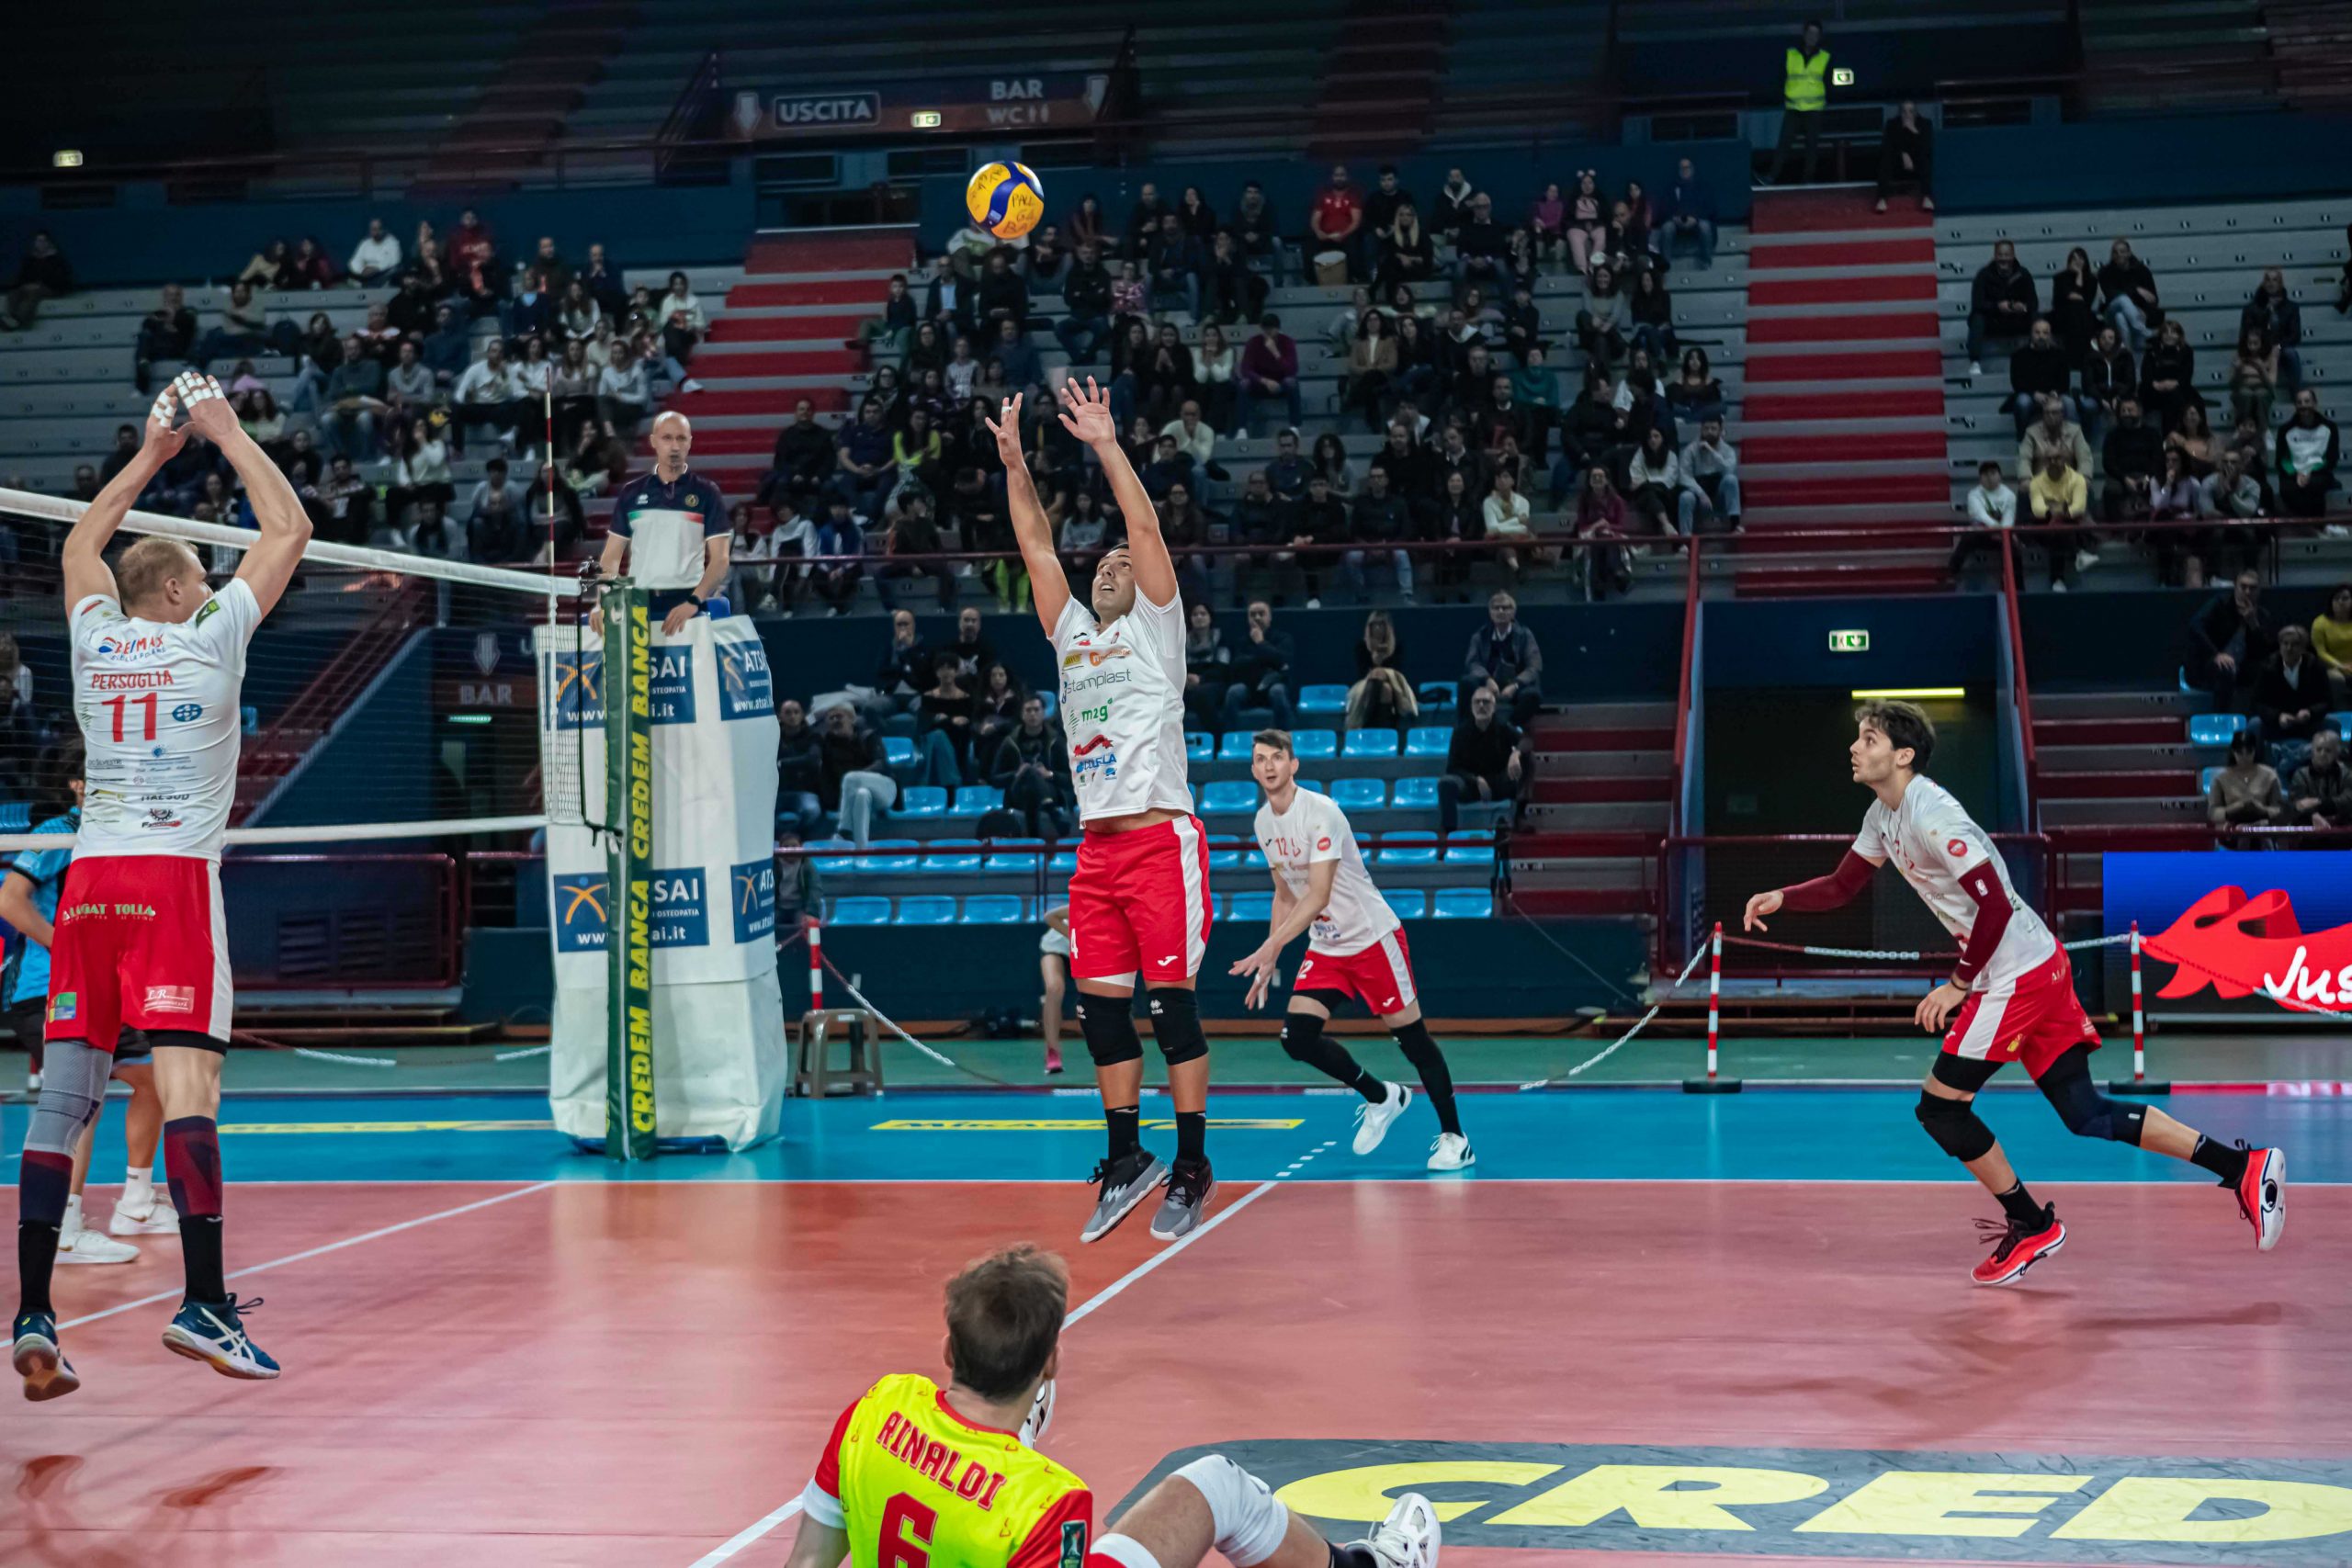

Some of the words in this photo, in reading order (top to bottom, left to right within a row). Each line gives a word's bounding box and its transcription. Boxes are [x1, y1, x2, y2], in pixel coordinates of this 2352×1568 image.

[991, 80, 1043, 100] BAR
[779, 98, 872, 122] USCITA
[988, 106, 1023, 124] WC
[632, 607, 650, 717] BANCA
[650, 655, 686, 679] SAI
[91, 670, 175, 690] PERSOGLIA
[652, 685, 686, 694] STEOPATIA
[1066, 669, 1132, 694] stamplast
[460, 684, 512, 705] BAR
[101, 692, 158, 742] 11
[632, 734, 650, 859] CREDEM
[654, 877, 699, 902] SAI
[657, 908, 699, 918] OSTEOPATIA
[630, 880, 650, 990] BANCA
[1070, 928, 1079, 959] 4
[630, 1005, 655, 1133] CREDEM
[876, 1410, 1007, 1511] RINALDI
[1274, 1460, 2352, 1543] CRED
[877, 1491, 939, 1568] 6
